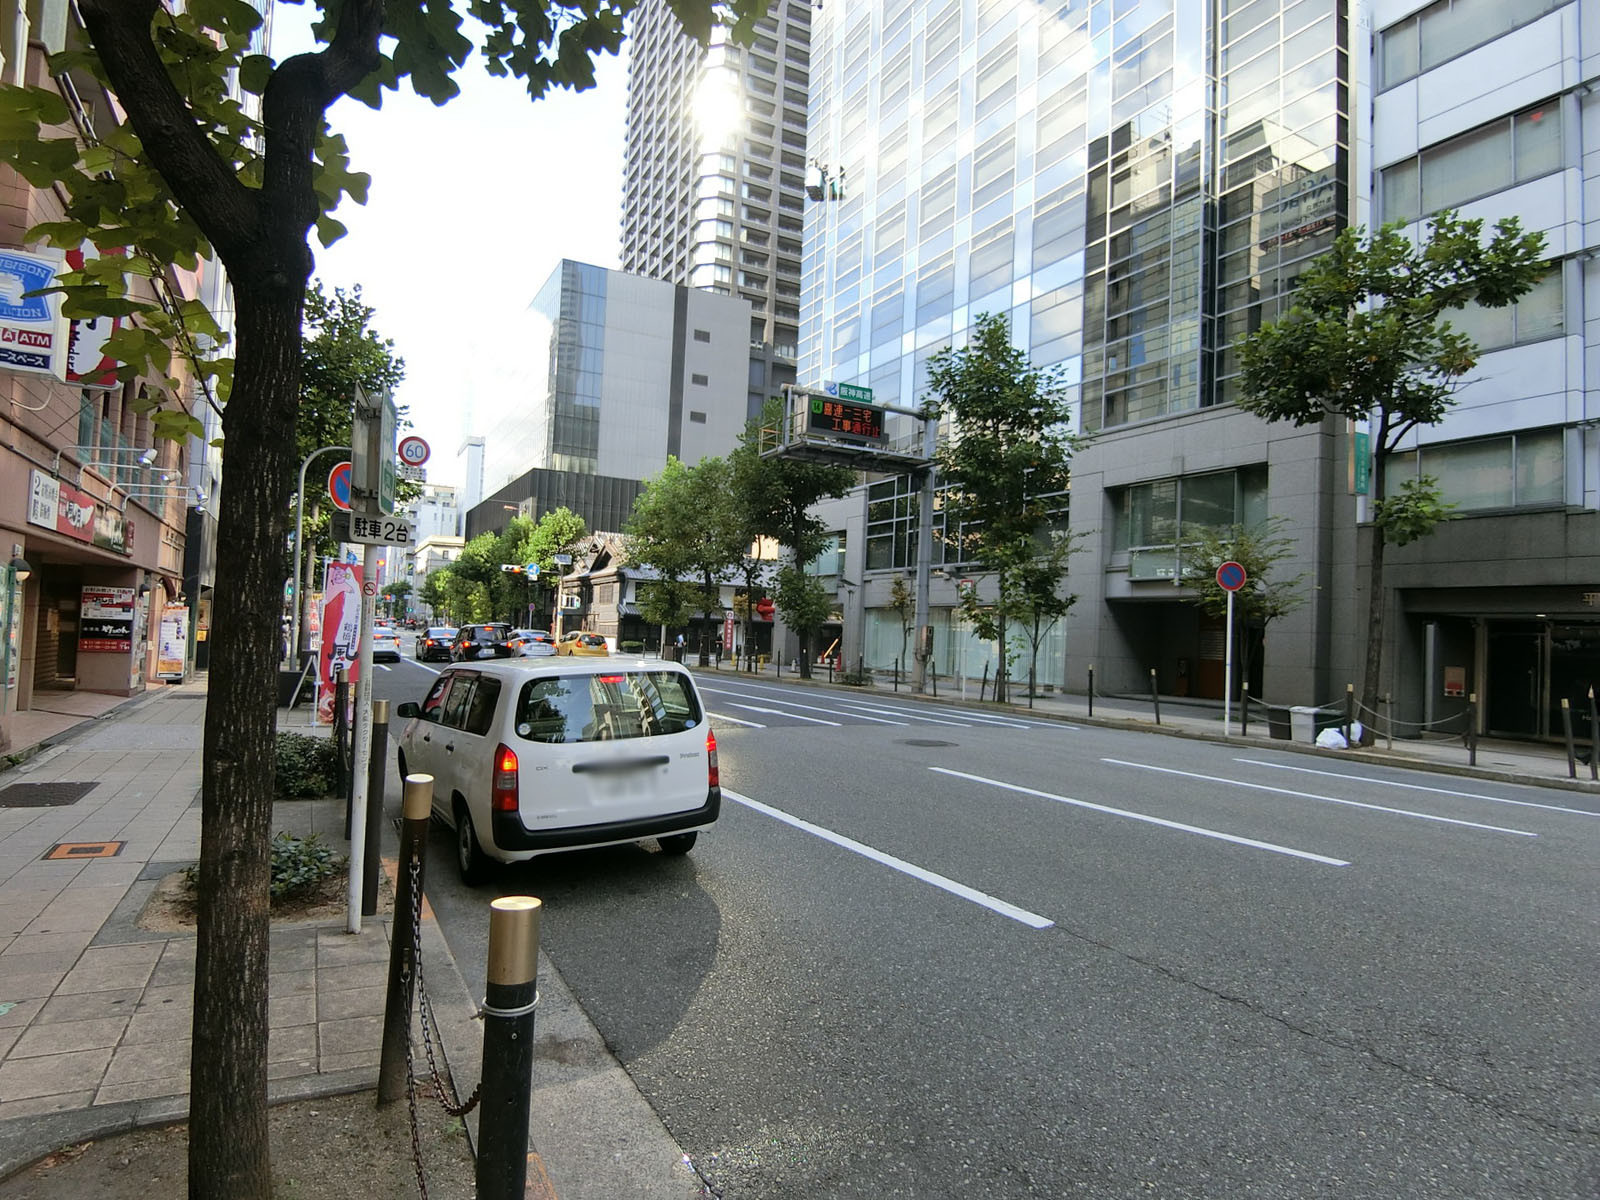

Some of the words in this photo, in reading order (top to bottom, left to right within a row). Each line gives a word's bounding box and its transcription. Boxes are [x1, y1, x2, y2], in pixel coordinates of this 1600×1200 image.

[19, 333, 50, 346] ATM
[840, 386, 872, 401] 阪神高速
[831, 418, 880, 438] 工事通行止
[406, 445, 424, 458] 60
[353, 517, 408, 542] 駐車2台
